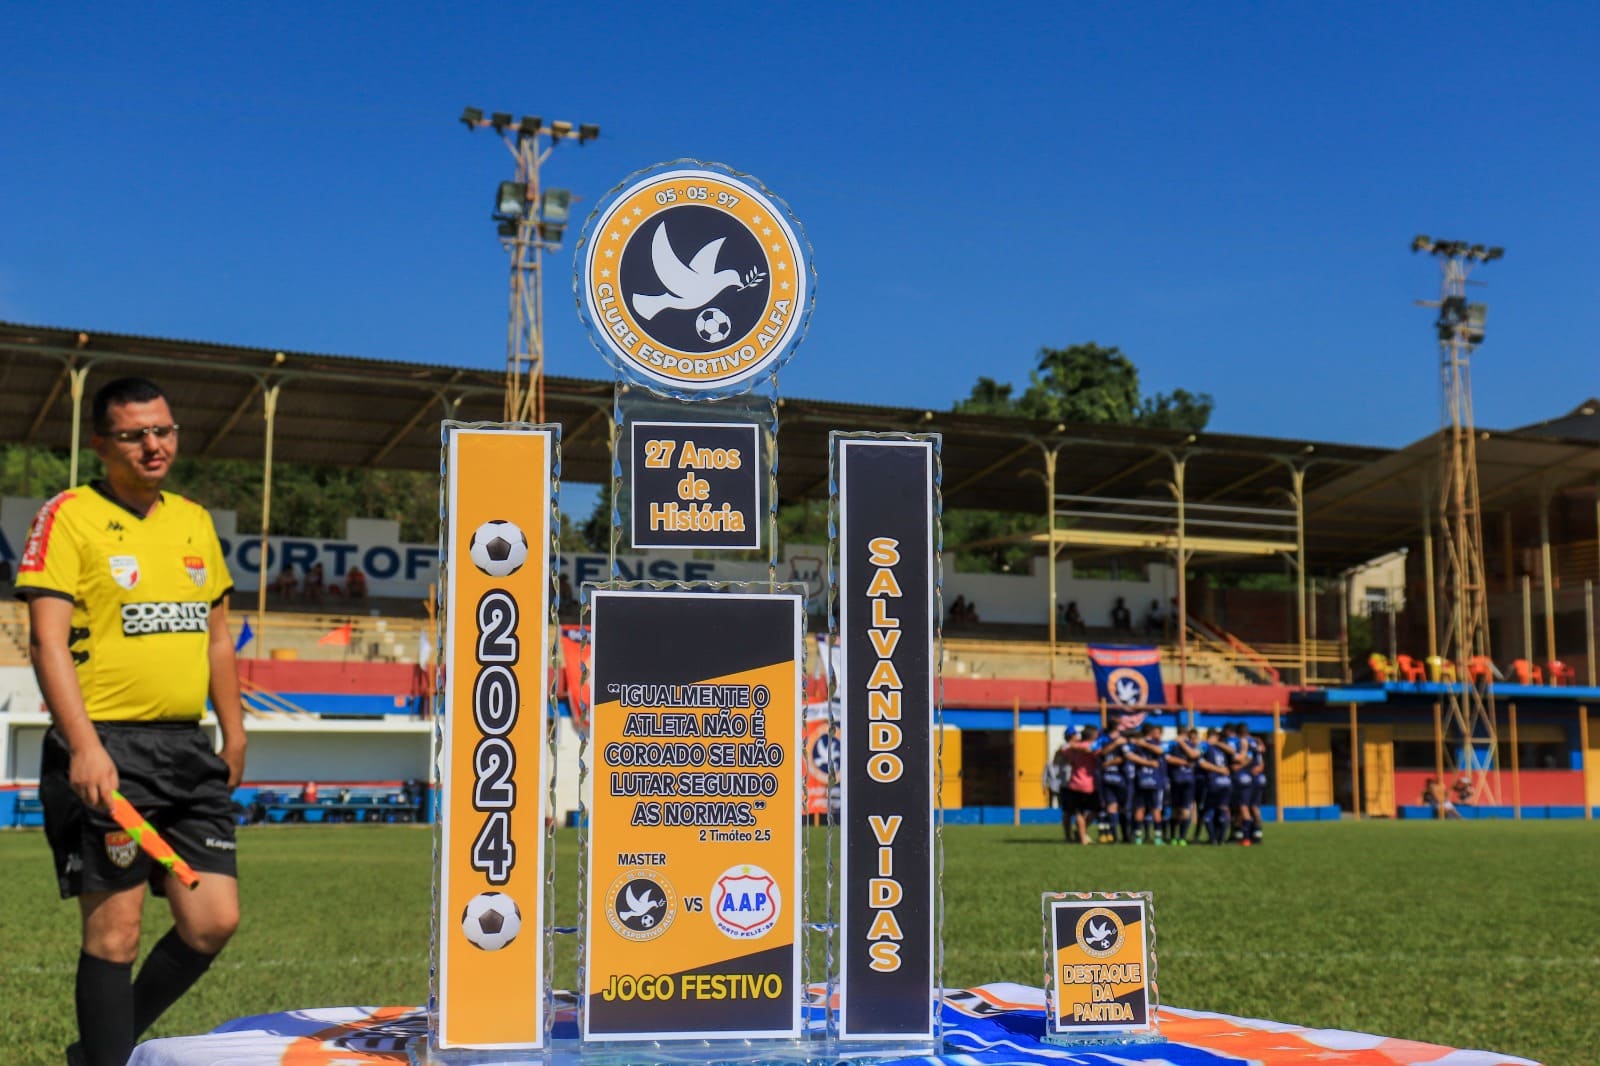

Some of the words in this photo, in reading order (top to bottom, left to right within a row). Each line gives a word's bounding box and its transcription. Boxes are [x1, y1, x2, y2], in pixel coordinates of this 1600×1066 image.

[598, 283, 639, 348] CLUBE
[637, 345, 756, 375] ESPORTIVO
[756, 299, 791, 349] ALFA
[645, 440, 676, 468] 27
[678, 441, 741, 469] Anos
[678, 472, 710, 500] de
[650, 502, 746, 532] História
[122, 602, 209, 620] ODONTO
[866, 537, 904, 783] SALVANDO
[753, 686, 770, 708] O
[623, 713, 700, 737] ATLETA
[702, 709, 747, 737] NÃO
[751, 708, 765, 738] É
[471, 589, 520, 885] 2024
[604, 743, 705, 766] COROADO
[708, 744, 735, 767] SE
[738, 740, 784, 767] NÃO
[611, 773, 678, 797] LUTAR
[677, 773, 778, 797] SEGUNDO
[631, 802, 661, 826] AS
[699, 830, 706, 841] 2
[710, 829, 752, 841] Timóteo
[755, 830, 771, 841] 2.5
[617, 853, 666, 865] MASTER
[684, 897, 703, 912] VS
[866, 815, 904, 973] VIDAS
[1063, 964, 1141, 984] DESTAQUE
[602, 975, 675, 1001] JOGO
[681, 974, 783, 1000] FESTIVO
[1091, 983, 1114, 1002] DA
[1073, 1003, 1134, 1022] PARTIDA
